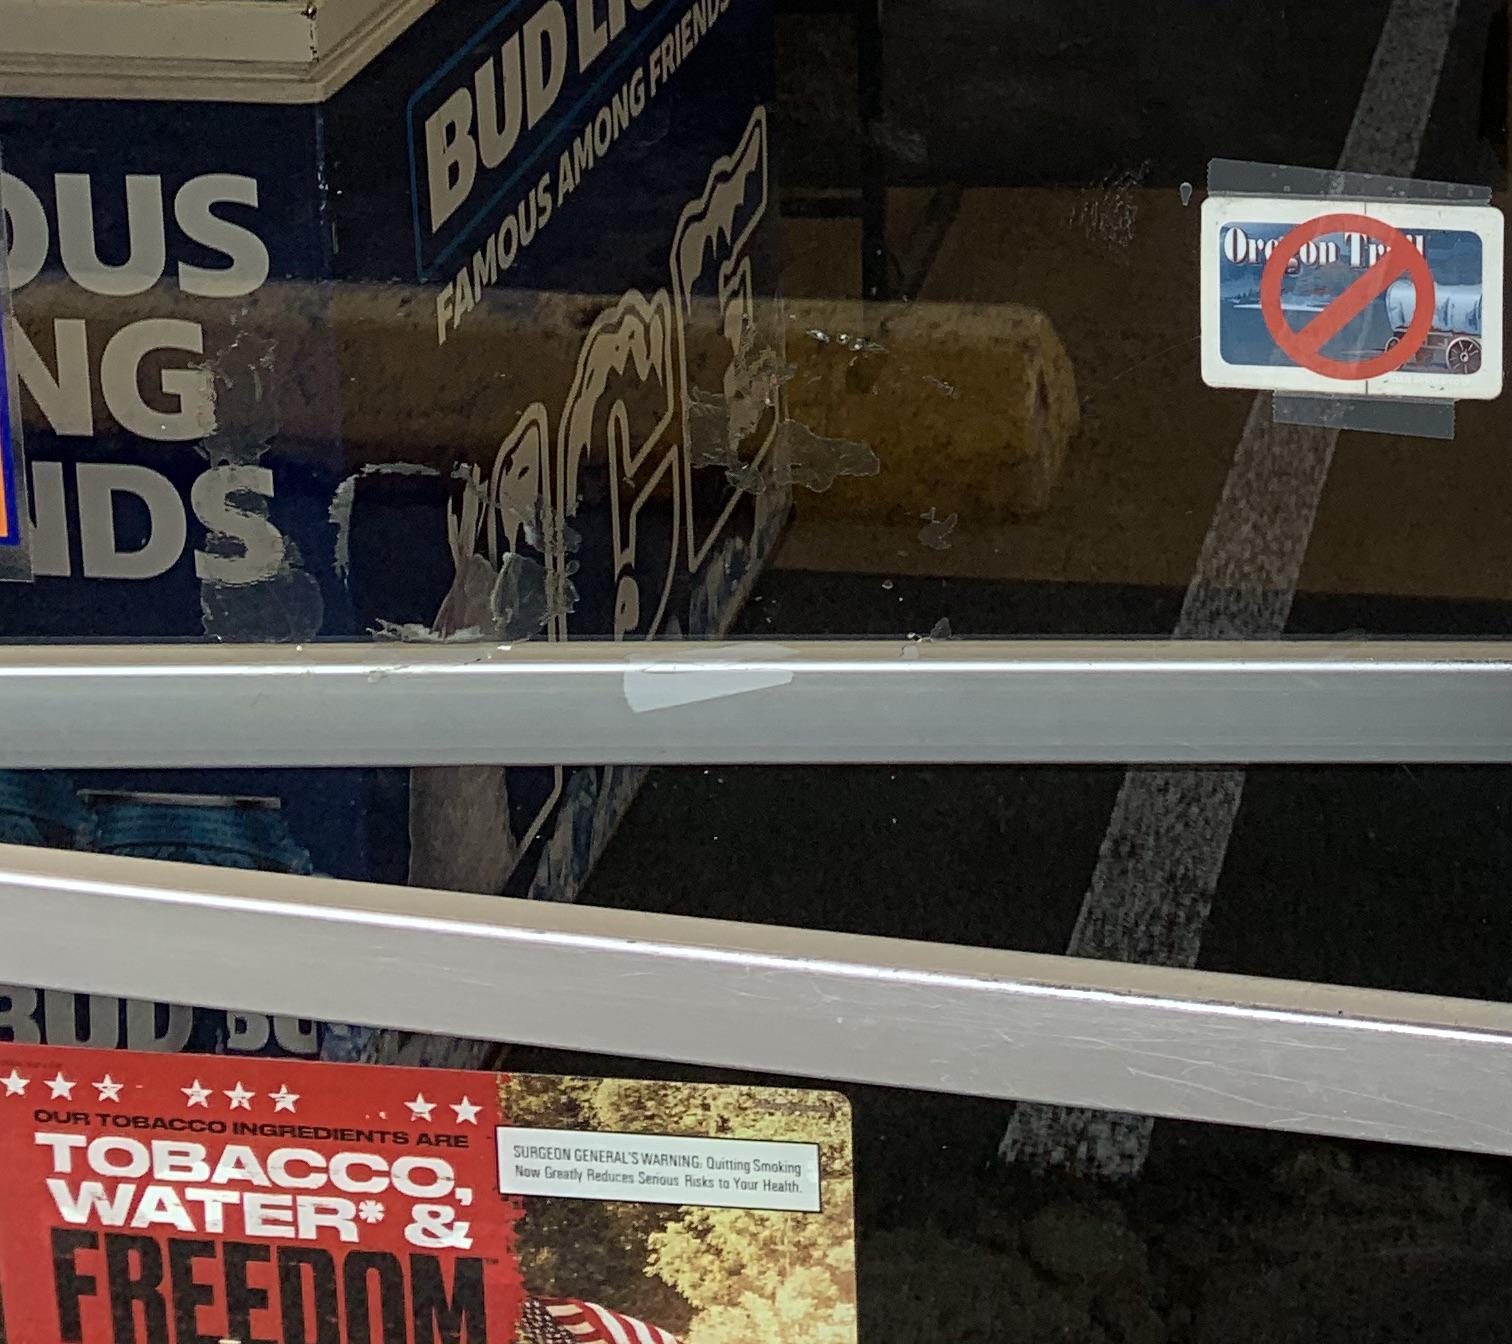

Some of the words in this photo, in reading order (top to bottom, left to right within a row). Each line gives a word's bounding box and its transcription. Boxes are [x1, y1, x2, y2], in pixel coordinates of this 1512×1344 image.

[425, 0, 568, 233] BUD
[436, 169, 553, 345] FAMOUS
[557, 67, 645, 207] AMONG
[1224, 226, 1341, 277] Oreon
[1344, 232, 1427, 270] Trl
[34, 1109, 91, 1125] OUR
[102, 1113, 227, 1134] TOBACCO
[233, 1122, 408, 1143] INGREDIENTS
[416, 1134, 469, 1147] ARE
[35, 1133, 472, 1206] TOBACCO,
[513, 1145, 571, 1160] SURGEON
[574, 1148, 638, 1164] GENERAL'S
[706, 1157, 751, 1174] Quitting
[753, 1160, 801, 1177] Smoking
[515, 1165, 540, 1178] Now
[545, 1167, 582, 1183] Greatly
[587, 1169, 634, 1184] Reduces
[638, 1172, 679, 1186] Serious
[684, 1174, 714, 1188] Risks
[718, 1178, 730, 1189] to
[734, 1178, 758, 1191] Your
[763, 1180, 802, 1193] Health.
[405, 1203, 473, 1250] &
[51, 1227, 486, 1344] FREEDOM
